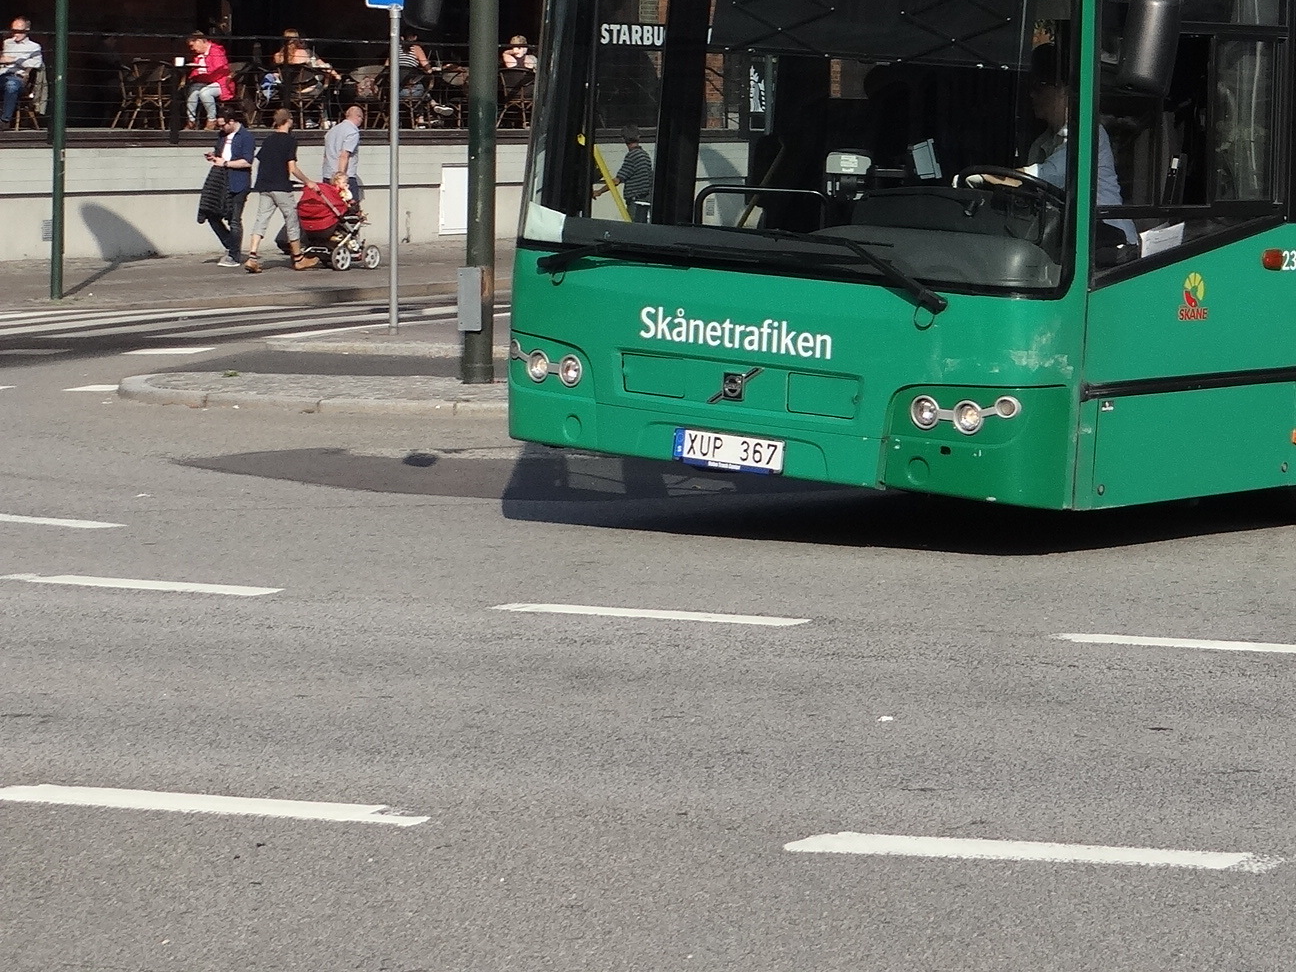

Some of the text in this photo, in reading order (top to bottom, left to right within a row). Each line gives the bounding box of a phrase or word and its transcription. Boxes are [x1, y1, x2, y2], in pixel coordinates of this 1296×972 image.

[600, 23, 666, 46] STARBU
[639, 306, 832, 360] Skånetrafiken
[687, 433, 778, 465] XUP 367
